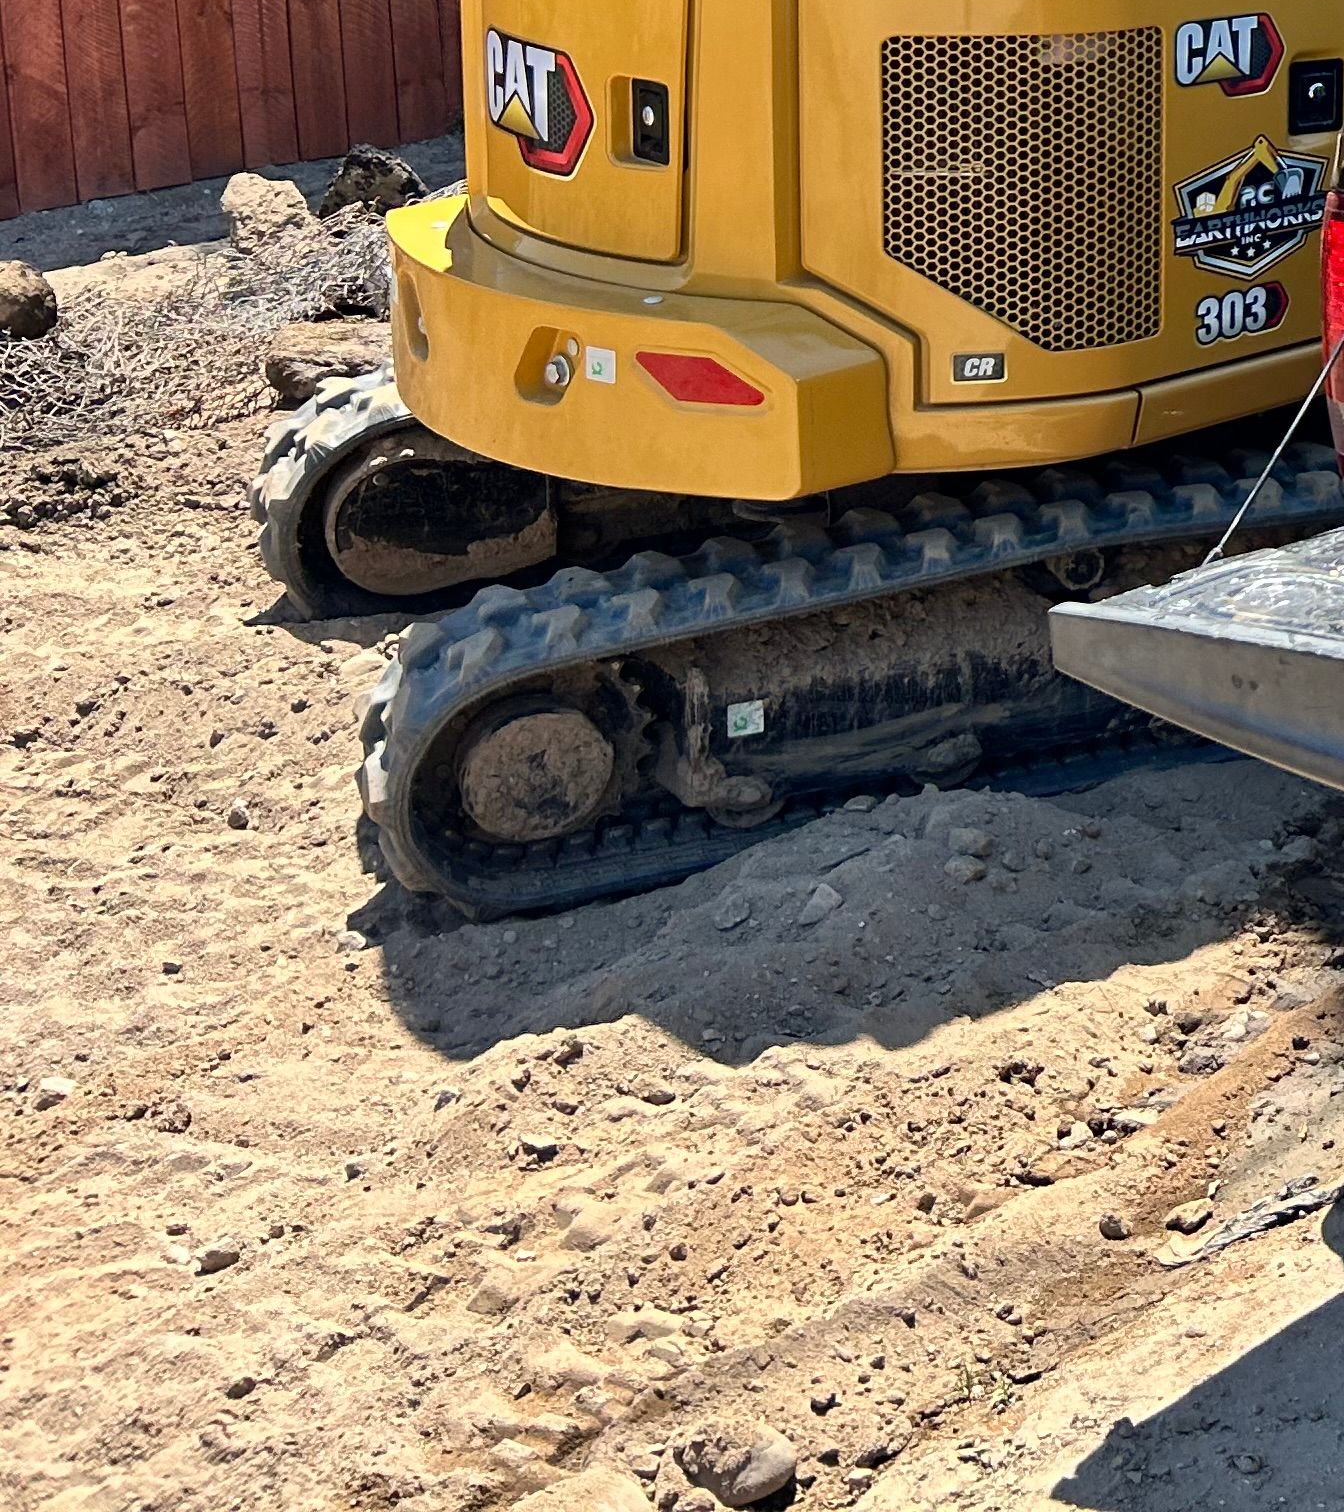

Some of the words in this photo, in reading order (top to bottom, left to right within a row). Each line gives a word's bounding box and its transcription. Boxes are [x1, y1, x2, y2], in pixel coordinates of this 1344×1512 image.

[1176, 15, 1259, 85] CAT
[486, 29, 557, 143] CAT
[1175, 196, 1325, 248] EARTHWORKS
[1240, 233, 1262, 245] INC
[1197, 286, 1268, 343] 303
[963, 357, 996, 377] CR
